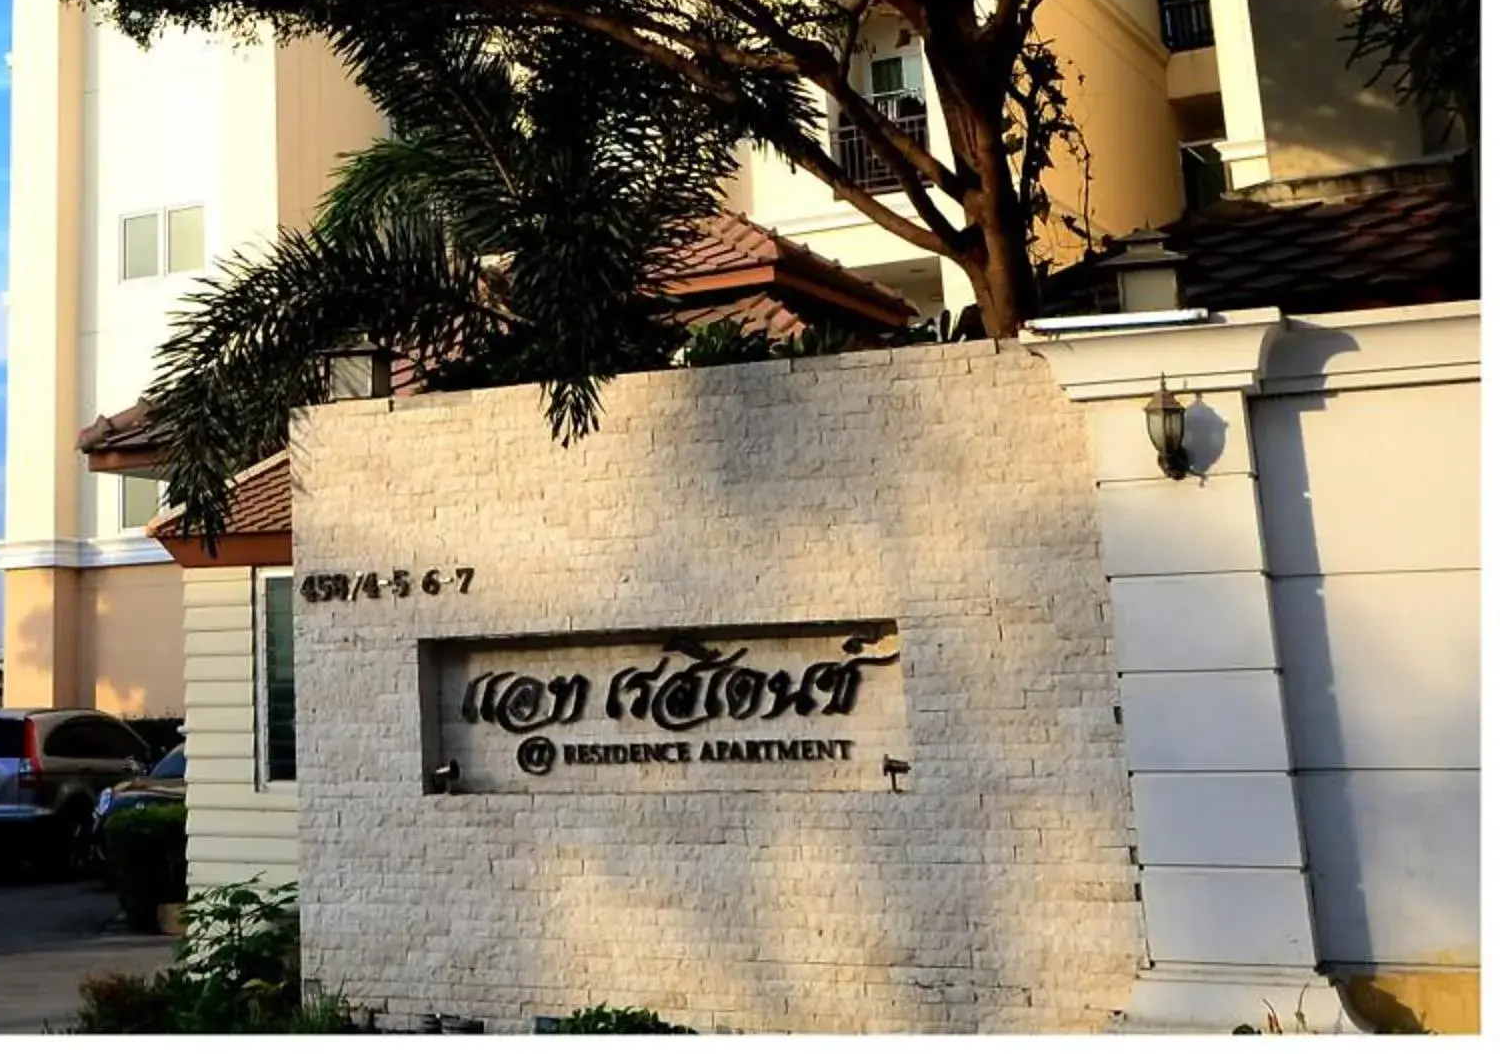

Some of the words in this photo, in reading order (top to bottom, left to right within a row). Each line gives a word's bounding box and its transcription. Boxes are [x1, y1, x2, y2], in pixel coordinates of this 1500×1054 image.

[421, 567, 475, 596] 6-7
[517, 735, 556, 775] @
[563, 742, 691, 764] RESIDENCE
[700, 739, 854, 762] APARTMENT
